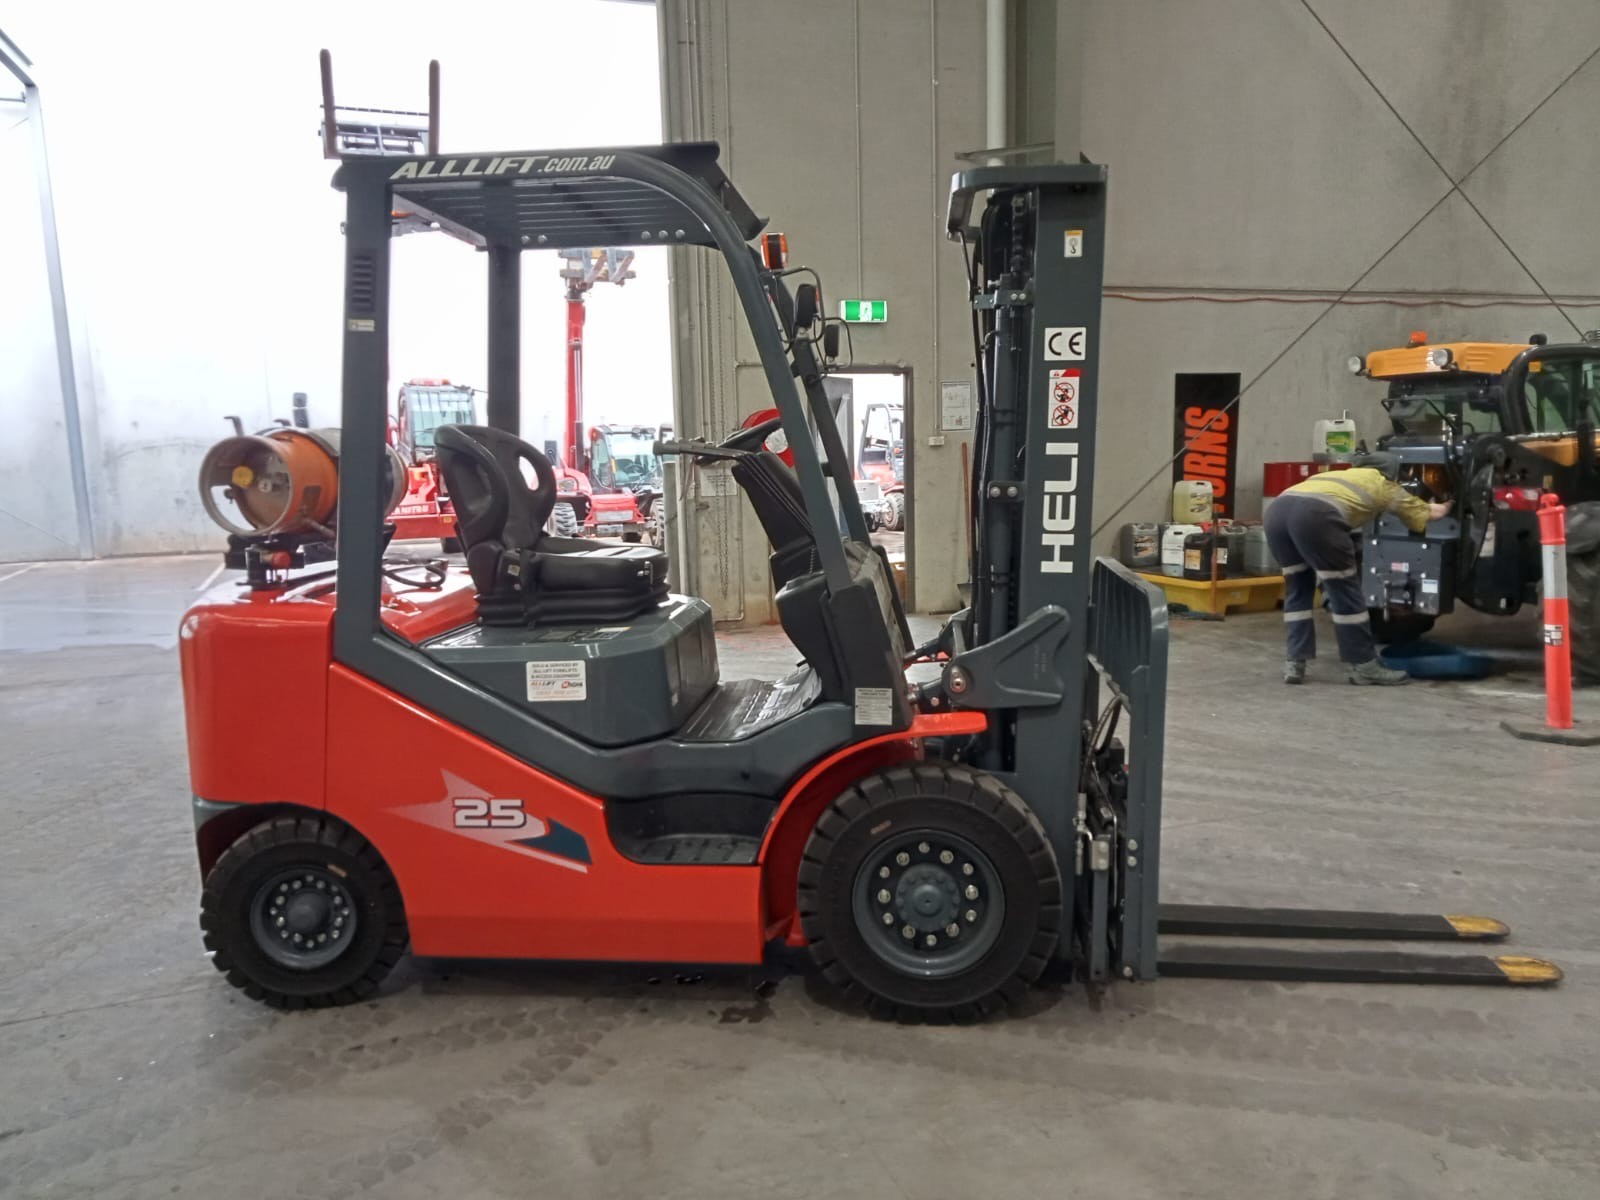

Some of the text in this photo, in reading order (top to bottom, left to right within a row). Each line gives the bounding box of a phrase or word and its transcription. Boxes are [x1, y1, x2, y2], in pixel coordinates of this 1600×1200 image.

[390, 154, 616, 180] ALLLIFT.com.au
[1048, 331, 1083, 356] CE
[1183, 406, 1230, 514] URNS
[1040, 442, 1079, 574] HELI
[453, 797, 527, 829] 25
